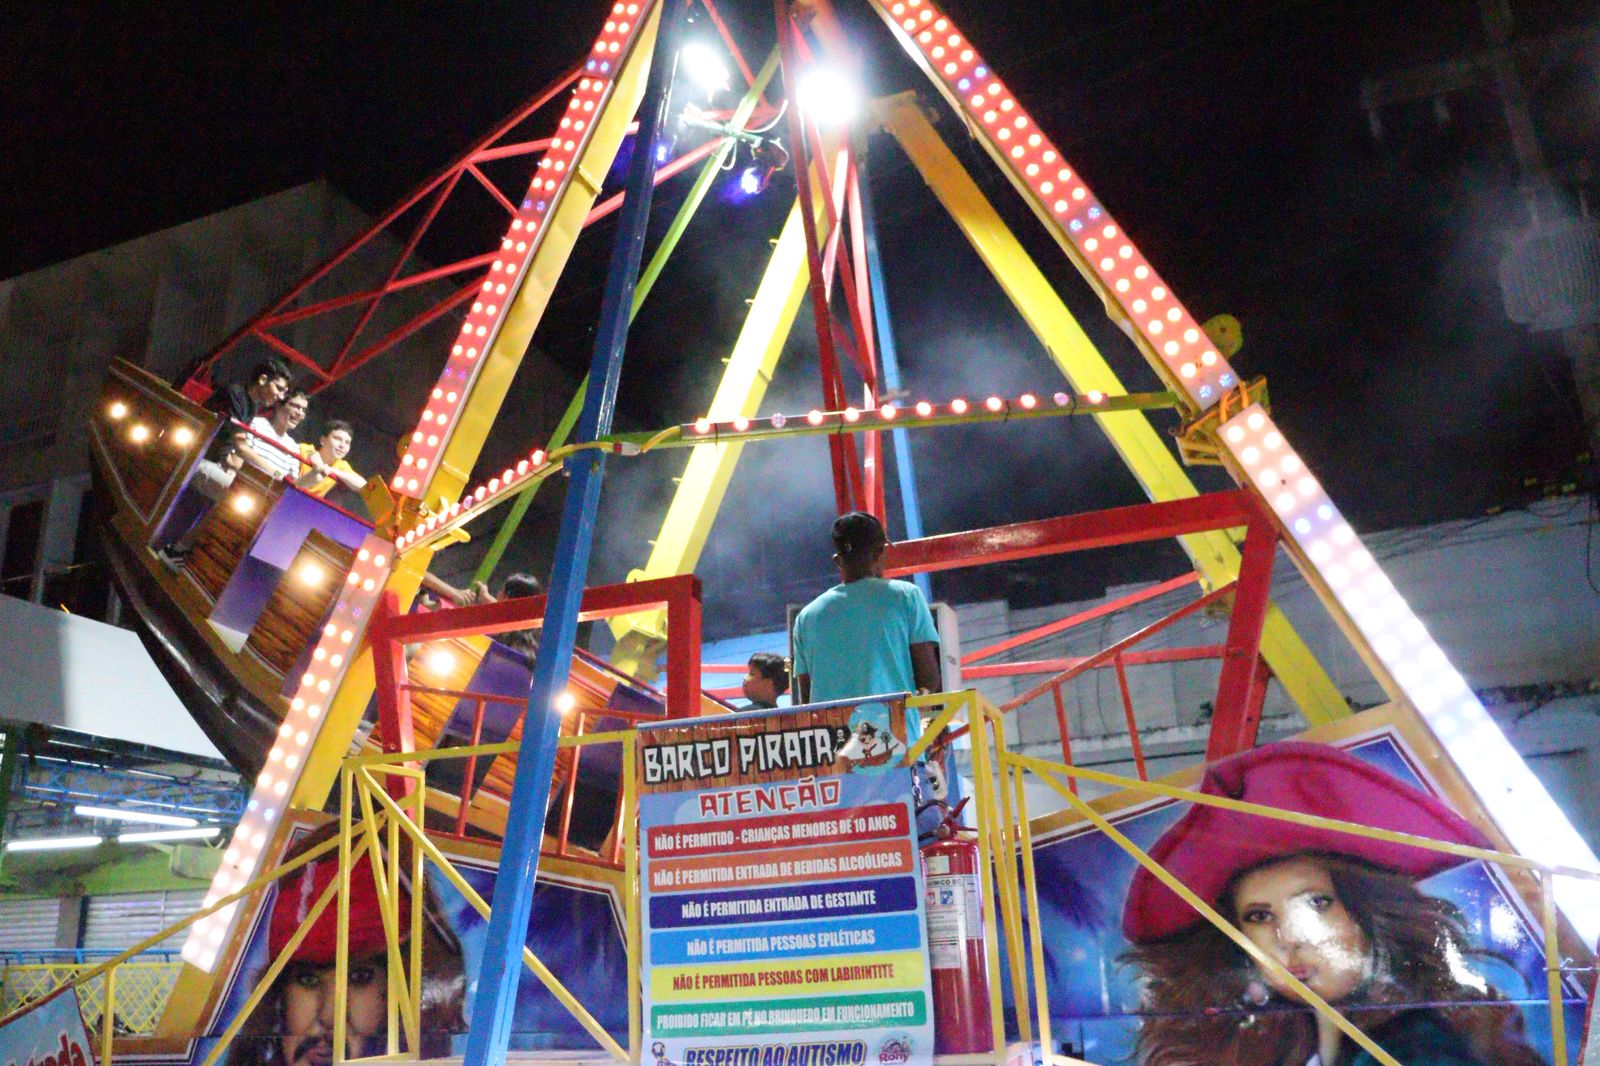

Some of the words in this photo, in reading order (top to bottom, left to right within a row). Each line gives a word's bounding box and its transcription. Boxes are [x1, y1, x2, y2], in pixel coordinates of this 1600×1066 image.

[643, 739, 730, 783] BARCO
[738, 728, 833, 772] PIRATA
[700, 776, 840, 817] ATENÇÃO
[654, 834, 674, 851] NÃO
[675, 833, 681, 849] É
[682, 831, 734, 848] PERMITIDO
[741, 825, 790, 844] CRIANÇAS
[792, 820, 838, 838] MENORES
[840, 819, 853, 834] DE
[854, 818, 867, 833] 10
[868, 814, 897, 831] ANOS
[653, 869, 674, 886] NÃO
[675, 868, 681, 885] É
[682, 867, 734, 884] PERMITIDA
[735, 863, 779, 880] ENTRADA
[780, 861, 793, 876] DE
[794, 857, 837, 876] BEBIDAS
[838, 852, 903, 872] ALCOÓLICAS
[681, 901, 702, 918] NÃO
[703, 900, 709, 917] É
[710, 899, 763, 916] PERMITIDA
[764, 895, 809, 913] ENTRADA
[810, 894, 824, 909] DE
[825, 890, 877, 908] GESTANTE
[687, 938, 708, 956] NÃO
[709, 938, 715, 955] É
[716, 936, 769, 953] PERMITIDA
[770, 933, 816, 951] PESSOAS
[818, 928, 876, 947] EPILÉTICAS
[673, 974, 693, 991] NÃO
[695, 973, 700, 989] É
[702, 972, 756, 989] PERMITIDA
[758, 968, 803, 986] PESSOAS
[804, 966, 829, 983] COM
[831, 963, 894, 982] LABIRINTITE
[656, 1012, 699, 1030] PROIBIDO
[700, 1010, 727, 1028] FICAR
[727, 1010, 741, 1027] EM
[742, 1008, 753, 1027] PÉ
[754, 1009, 767, 1026] NO
[821, 1005, 835, 1022] EM
[836, 1001, 914, 1022] FUNCIONAMENTO
[685, 1046, 760, 1066] RESPEITO
[762, 1045, 786, 1066] AO
[787, 1042, 864, 1066] AUTISMO
